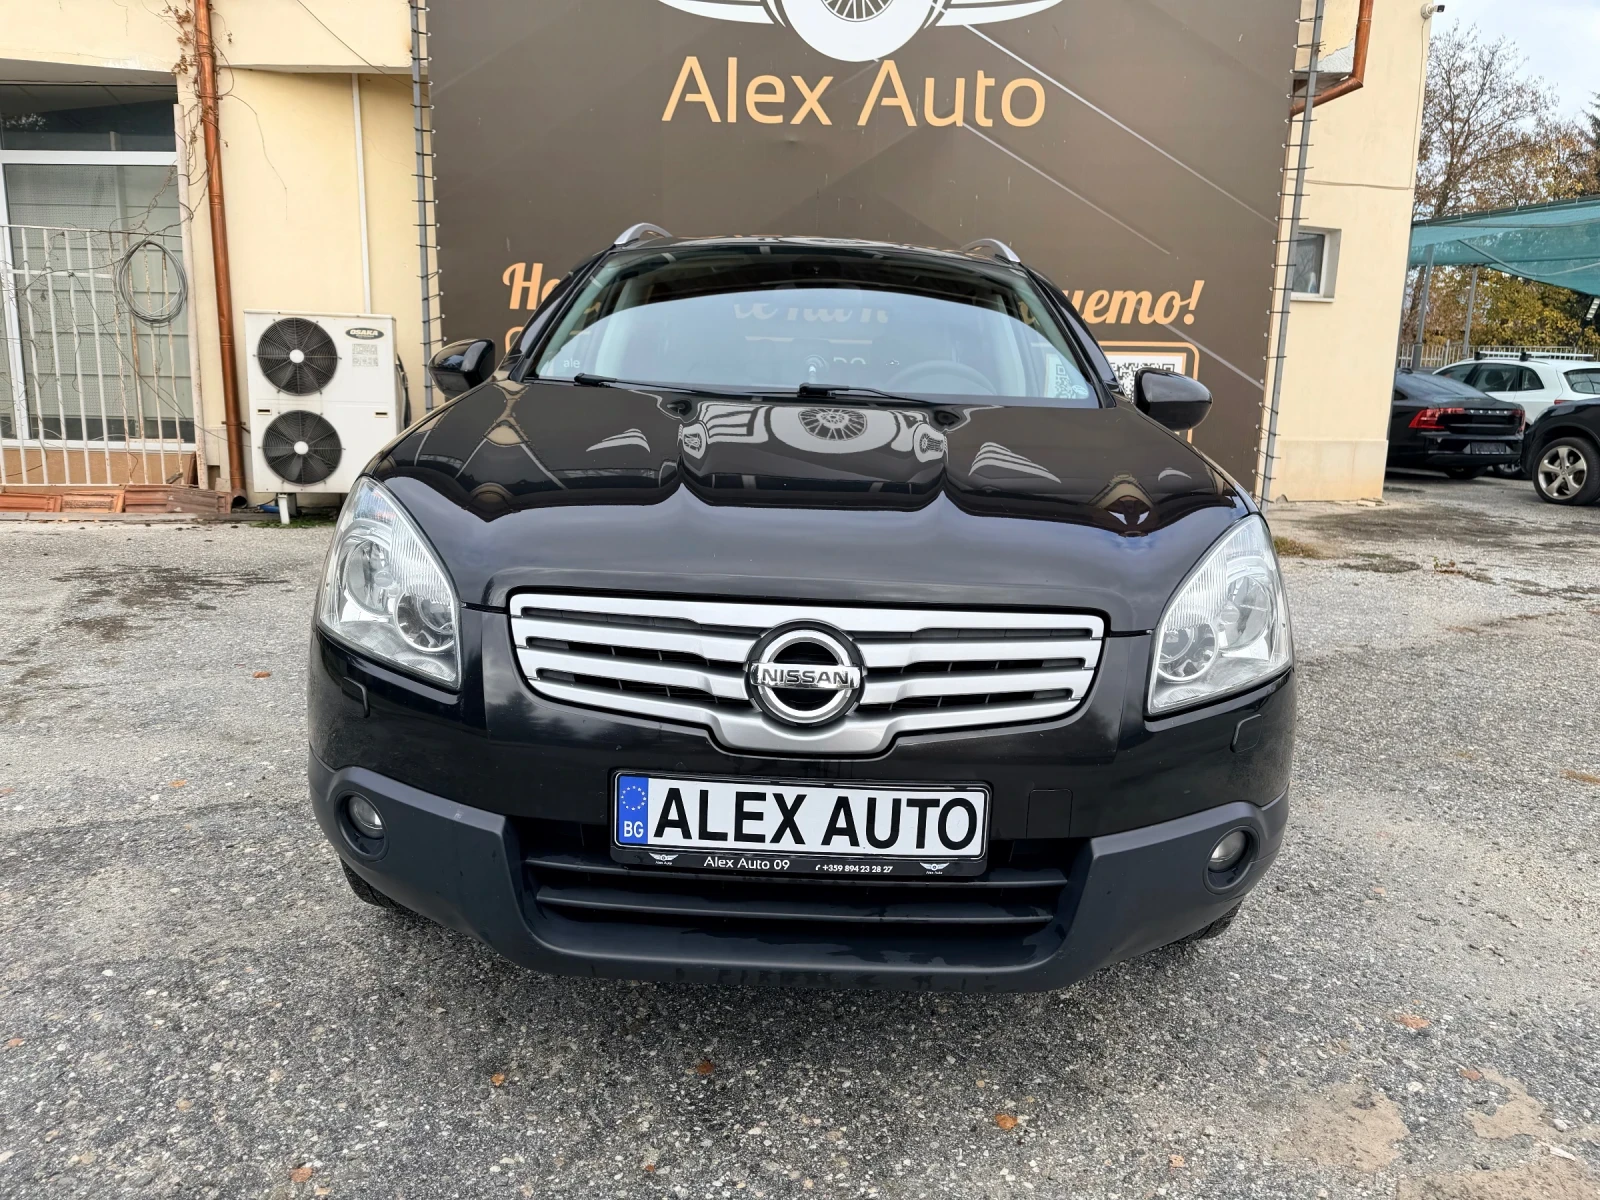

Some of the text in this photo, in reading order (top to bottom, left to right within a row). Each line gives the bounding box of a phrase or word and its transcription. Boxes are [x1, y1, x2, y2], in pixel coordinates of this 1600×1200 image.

[661, 55, 1046, 127] Alex Auto
[761, 668, 849, 685] NISSAN
[653, 787, 978, 851] ALEX AUTO
[623, 820, 644, 839] BG
[703, 856, 790, 870] Alex Auto 09
[822, 864, 894, 873] +359 894 23 28 27
